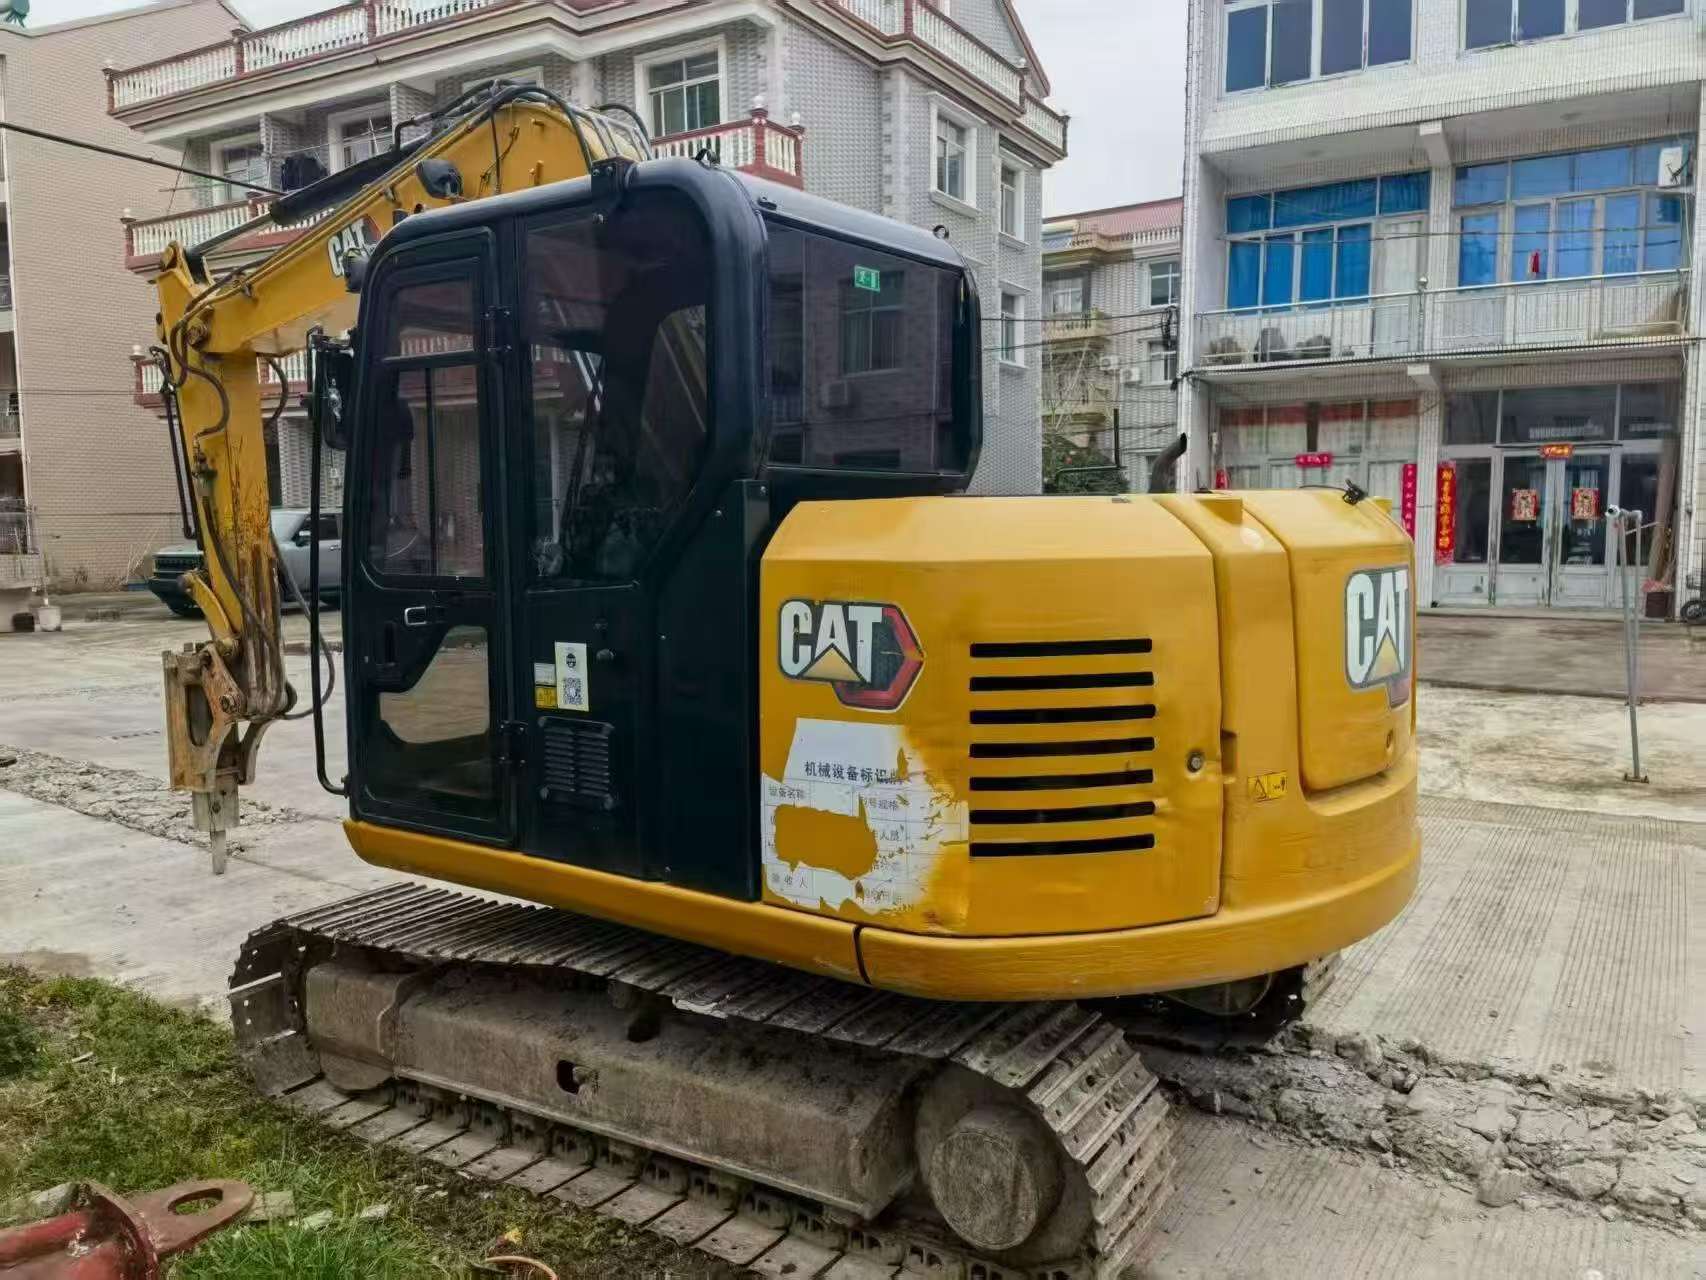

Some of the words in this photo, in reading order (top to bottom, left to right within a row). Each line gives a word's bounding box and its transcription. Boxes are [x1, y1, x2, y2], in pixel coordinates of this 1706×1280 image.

[328, 218, 370, 276] CAT
[780, 600, 883, 683] CAT
[1346, 570, 1408, 684] CAT
